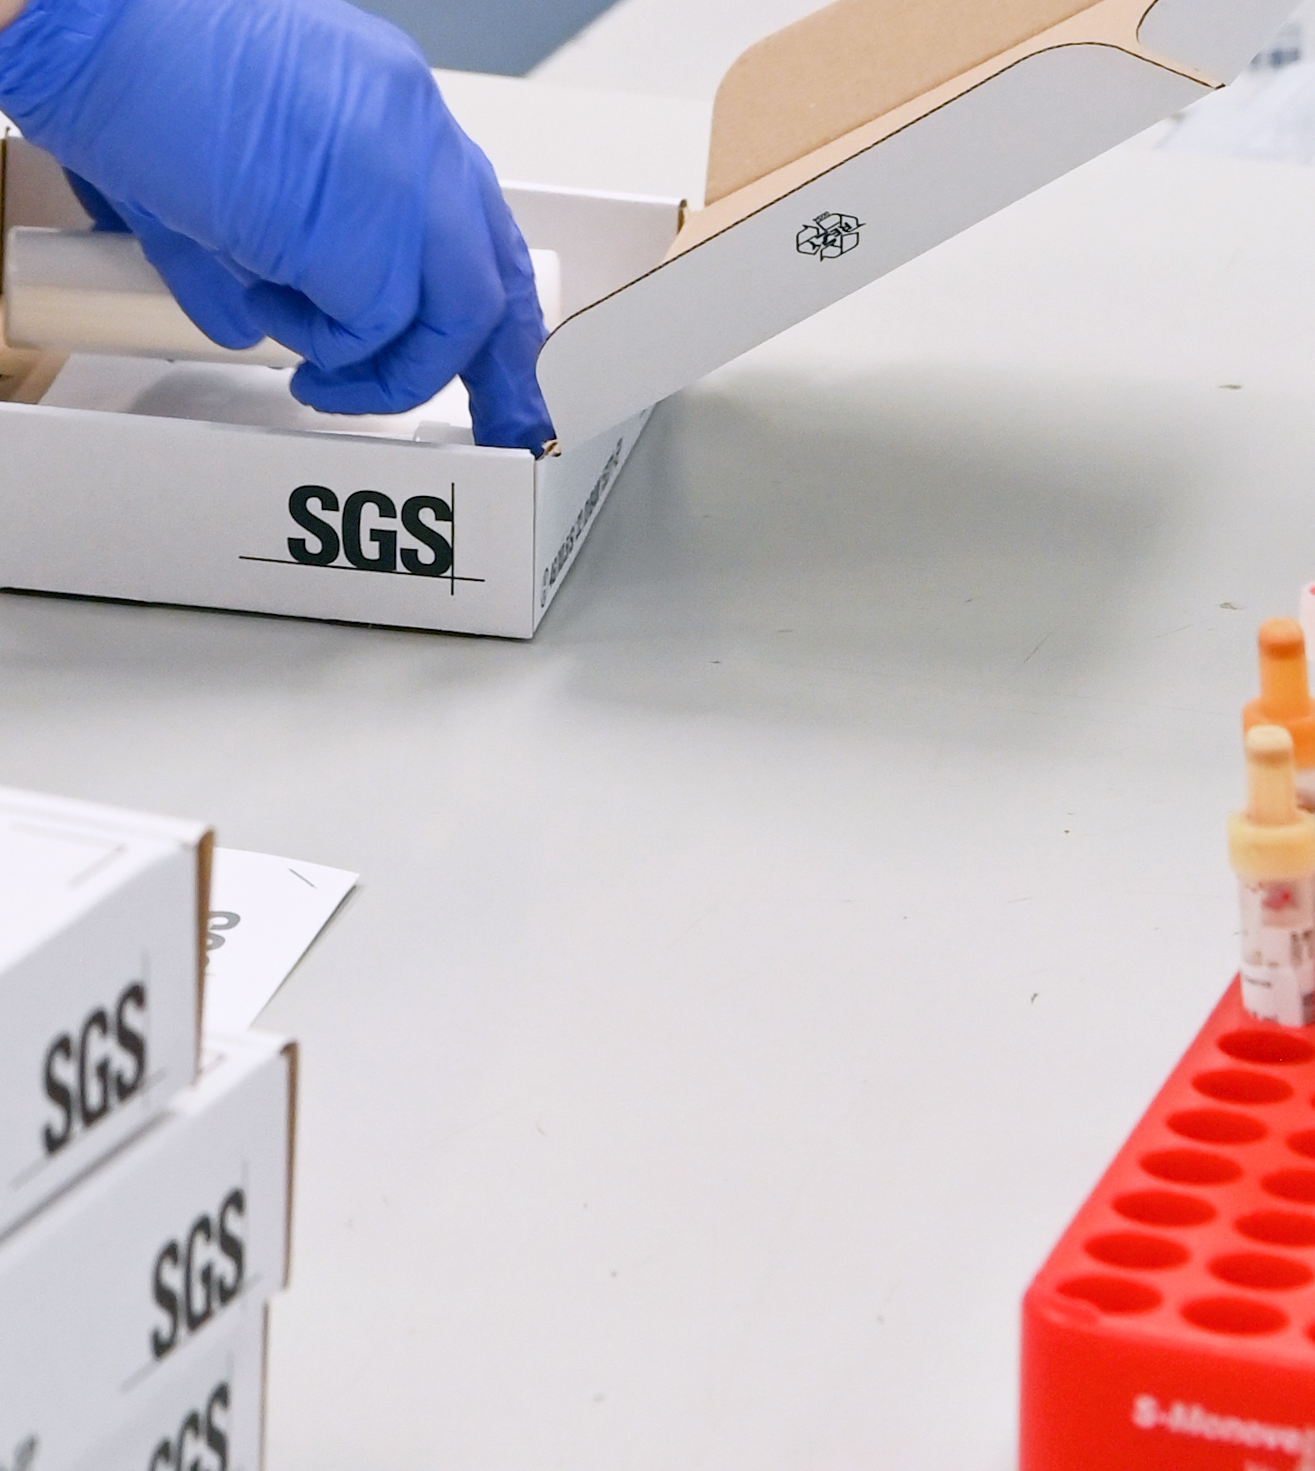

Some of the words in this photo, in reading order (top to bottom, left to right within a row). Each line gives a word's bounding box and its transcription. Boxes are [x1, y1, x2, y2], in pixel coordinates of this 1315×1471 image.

[287, 484, 454, 576] SGS
[41, 980, 147, 1158] SGS
[150, 1188, 245, 1362] SGS
